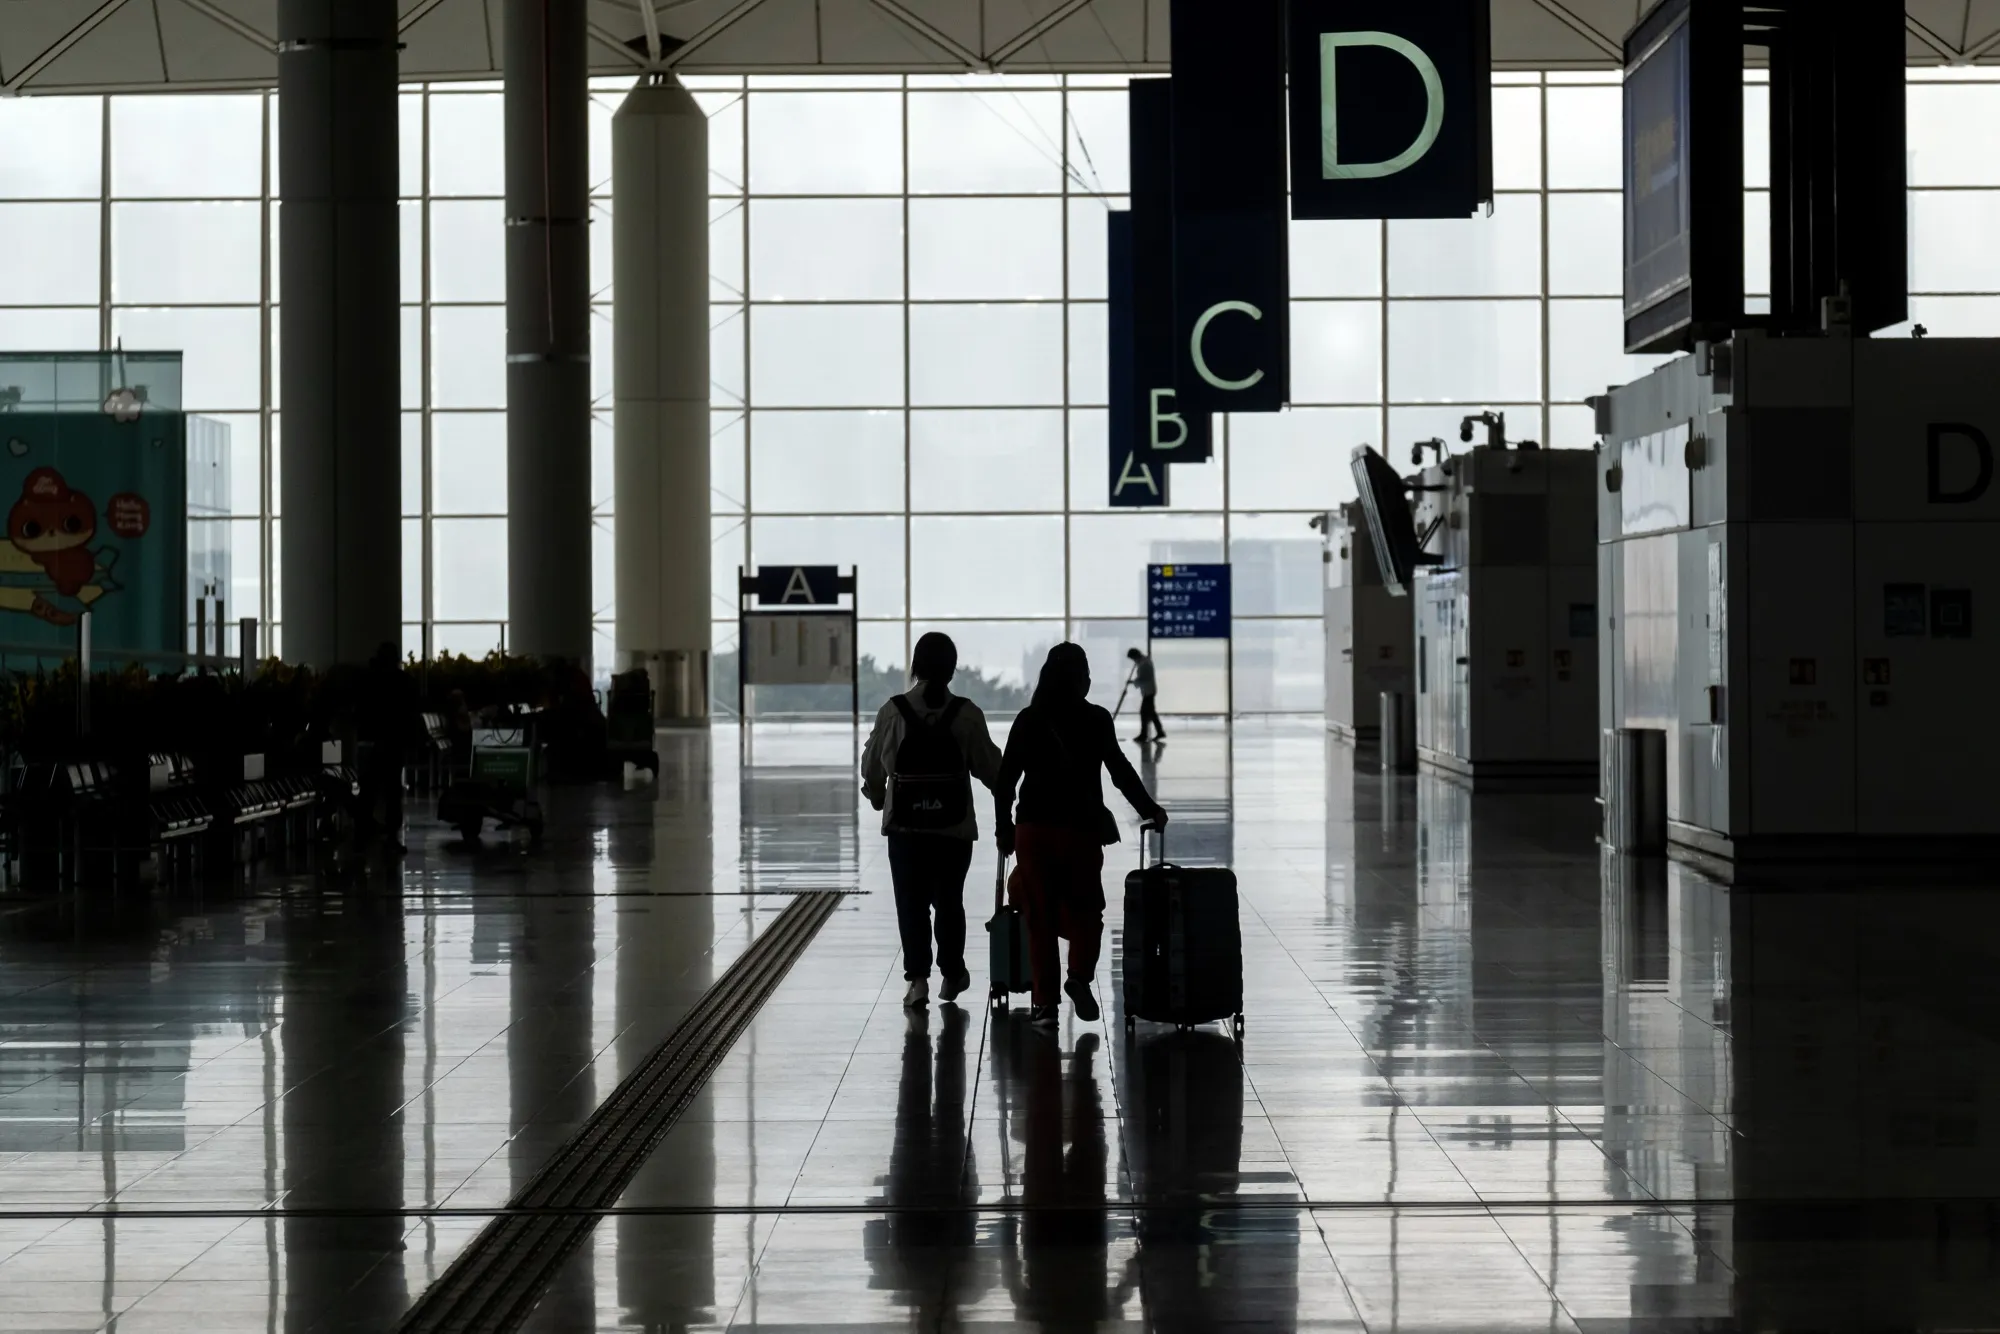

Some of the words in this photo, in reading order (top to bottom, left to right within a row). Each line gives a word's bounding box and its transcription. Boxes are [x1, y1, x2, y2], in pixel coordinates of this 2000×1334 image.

[1319, 30, 1445, 180] D
[1190, 300, 1265, 391] C
[1149, 388, 1189, 450] B
[1113, 450, 1159, 496] A
[1926, 422, 1994, 504] D
[780, 567, 816, 603] A
[912, 797, 945, 811] FILA
